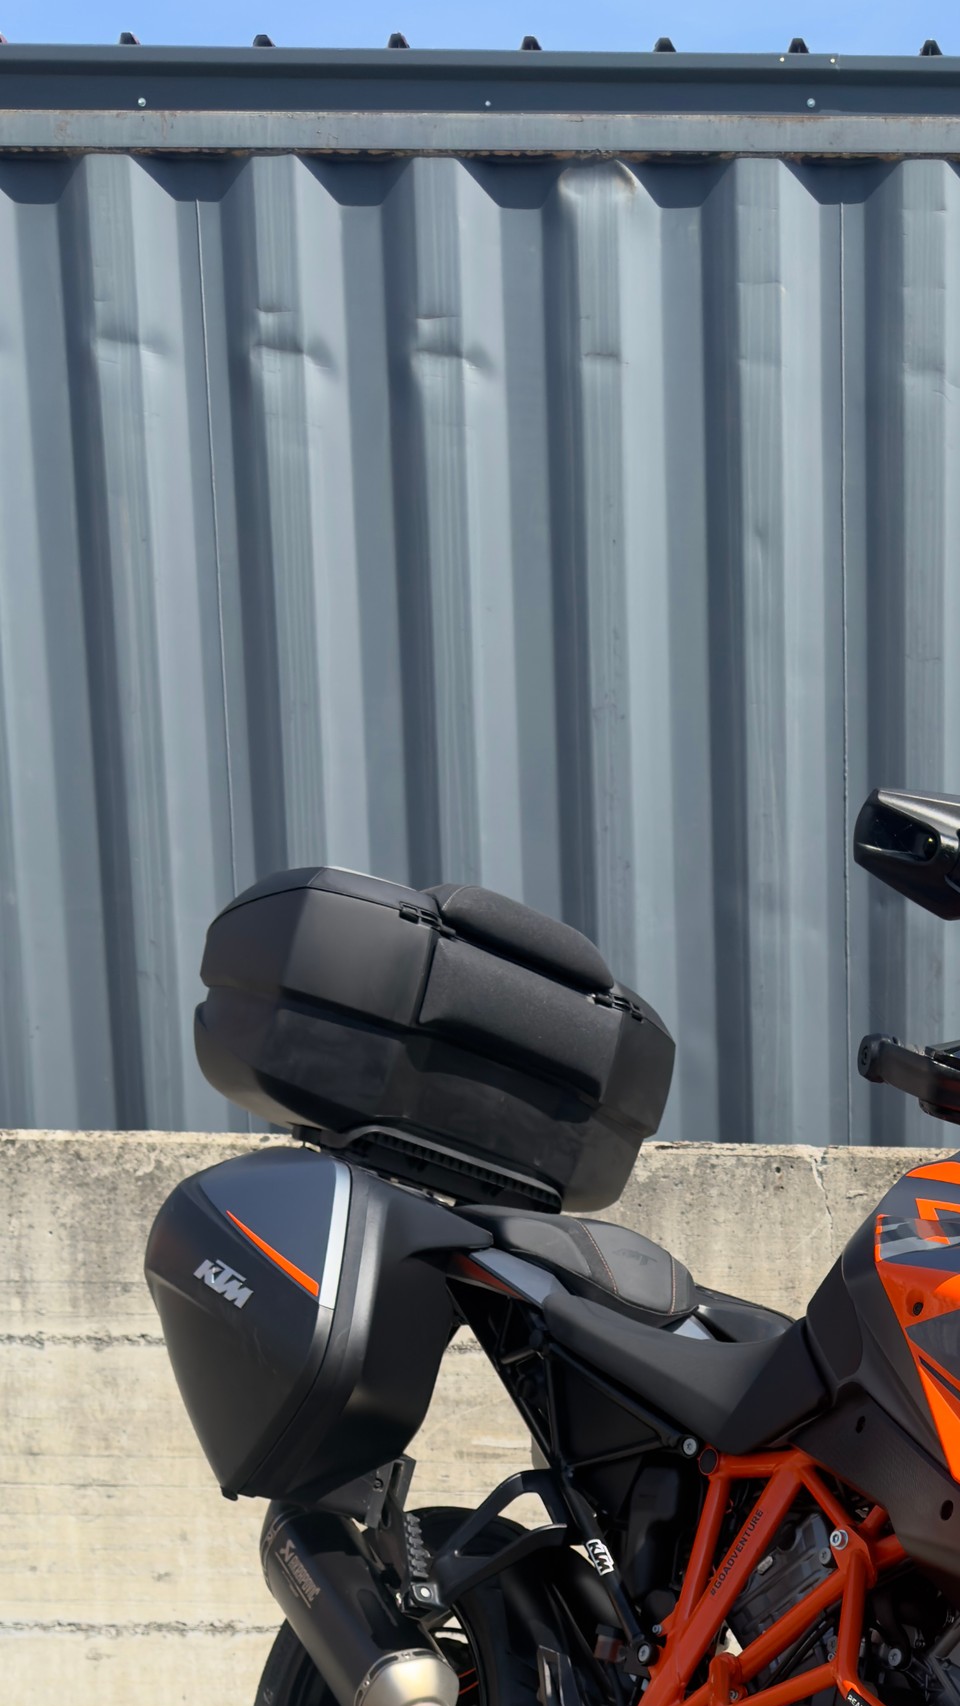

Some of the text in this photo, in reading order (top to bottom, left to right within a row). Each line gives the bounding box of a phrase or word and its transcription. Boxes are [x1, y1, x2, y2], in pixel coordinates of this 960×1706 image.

[193, 1259, 254, 1309] KTM
[587, 1539, 614, 1576] KTM
[710, 1509, 764, 1596] #GOADVENTURE
